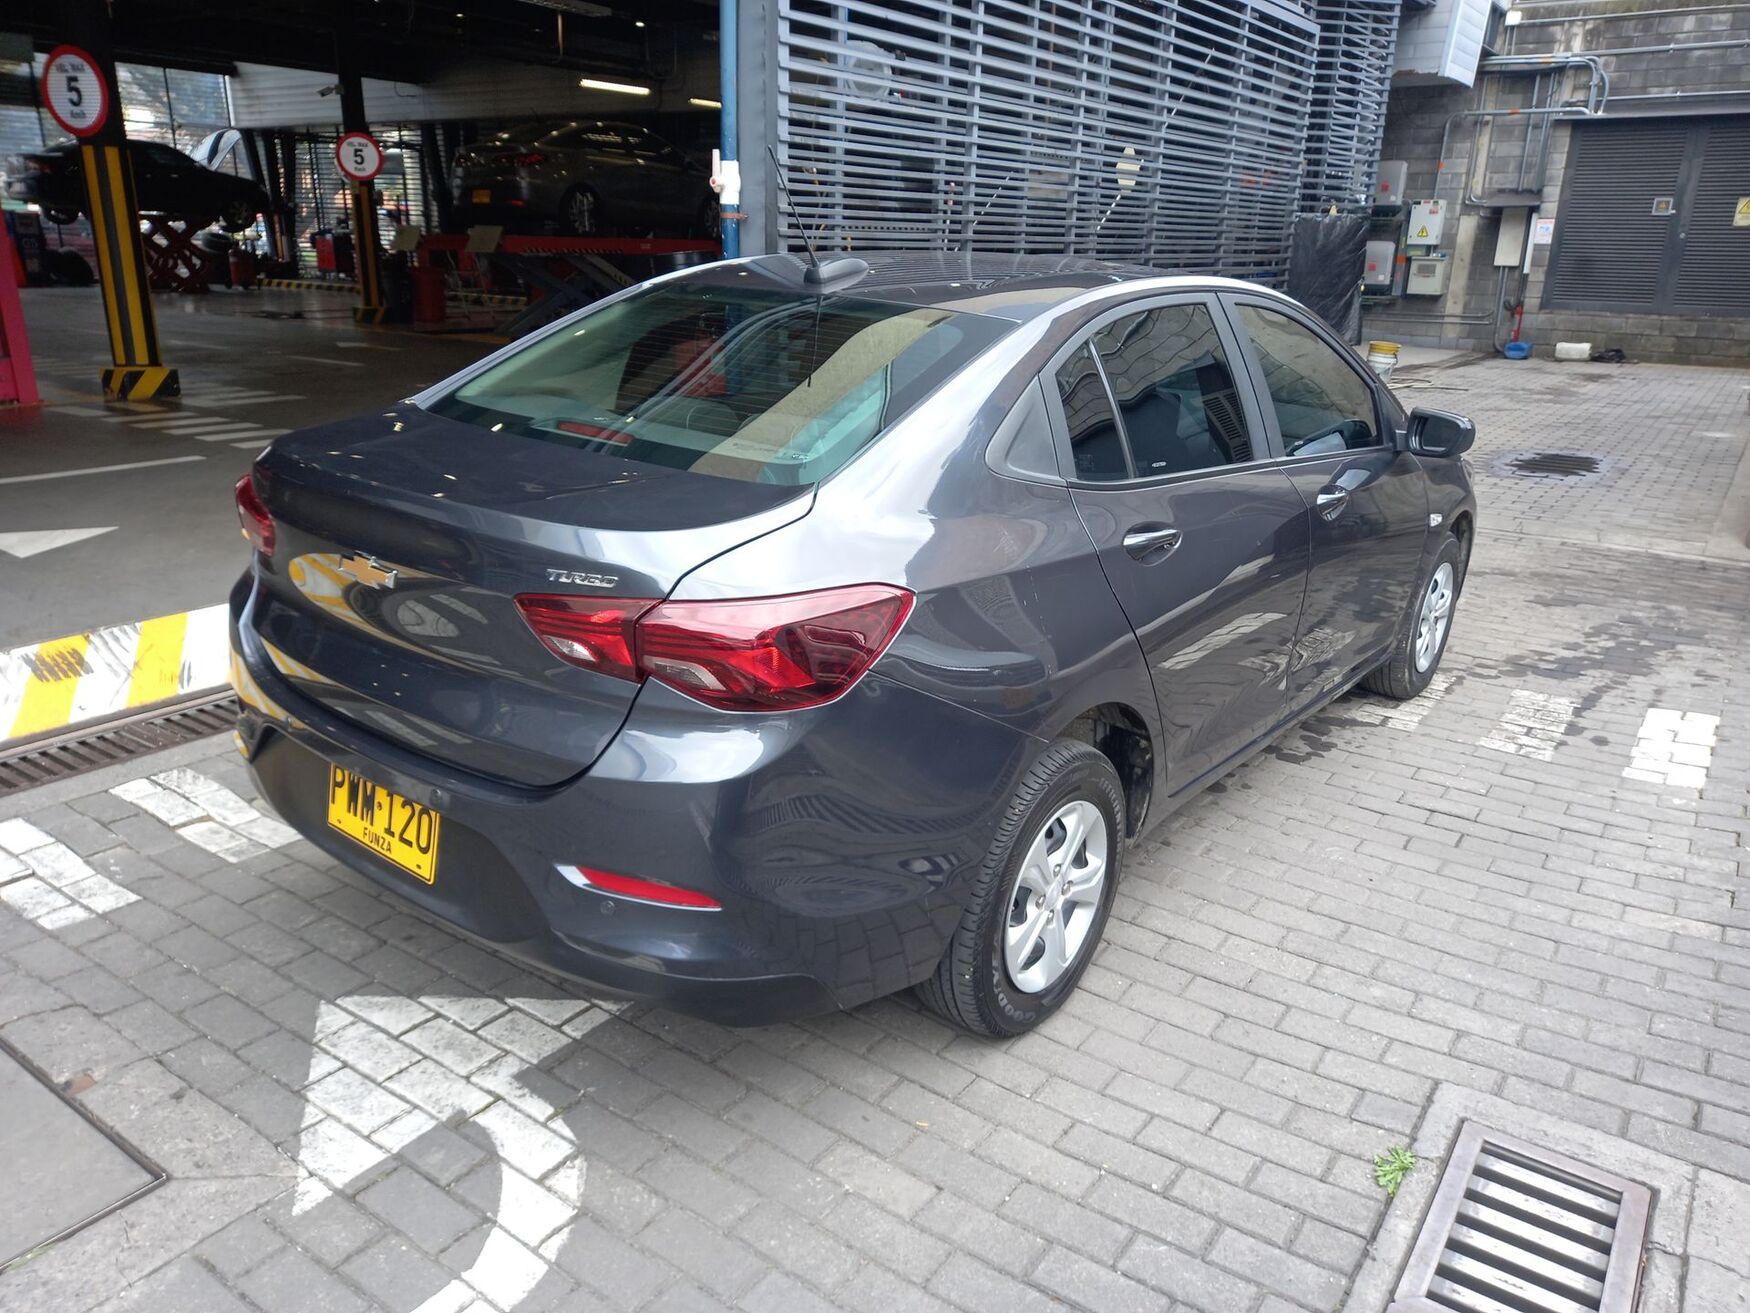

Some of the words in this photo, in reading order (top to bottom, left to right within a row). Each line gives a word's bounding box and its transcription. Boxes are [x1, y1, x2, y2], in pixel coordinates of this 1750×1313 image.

[66, 75, 82, 106] 5
[353, 148, 364, 165] 5
[545, 568, 619, 588] TURBO
[332, 767, 375, 826] PWM
[384, 790, 432, 855] 120
[363, 826, 393, 854] FUNZA
